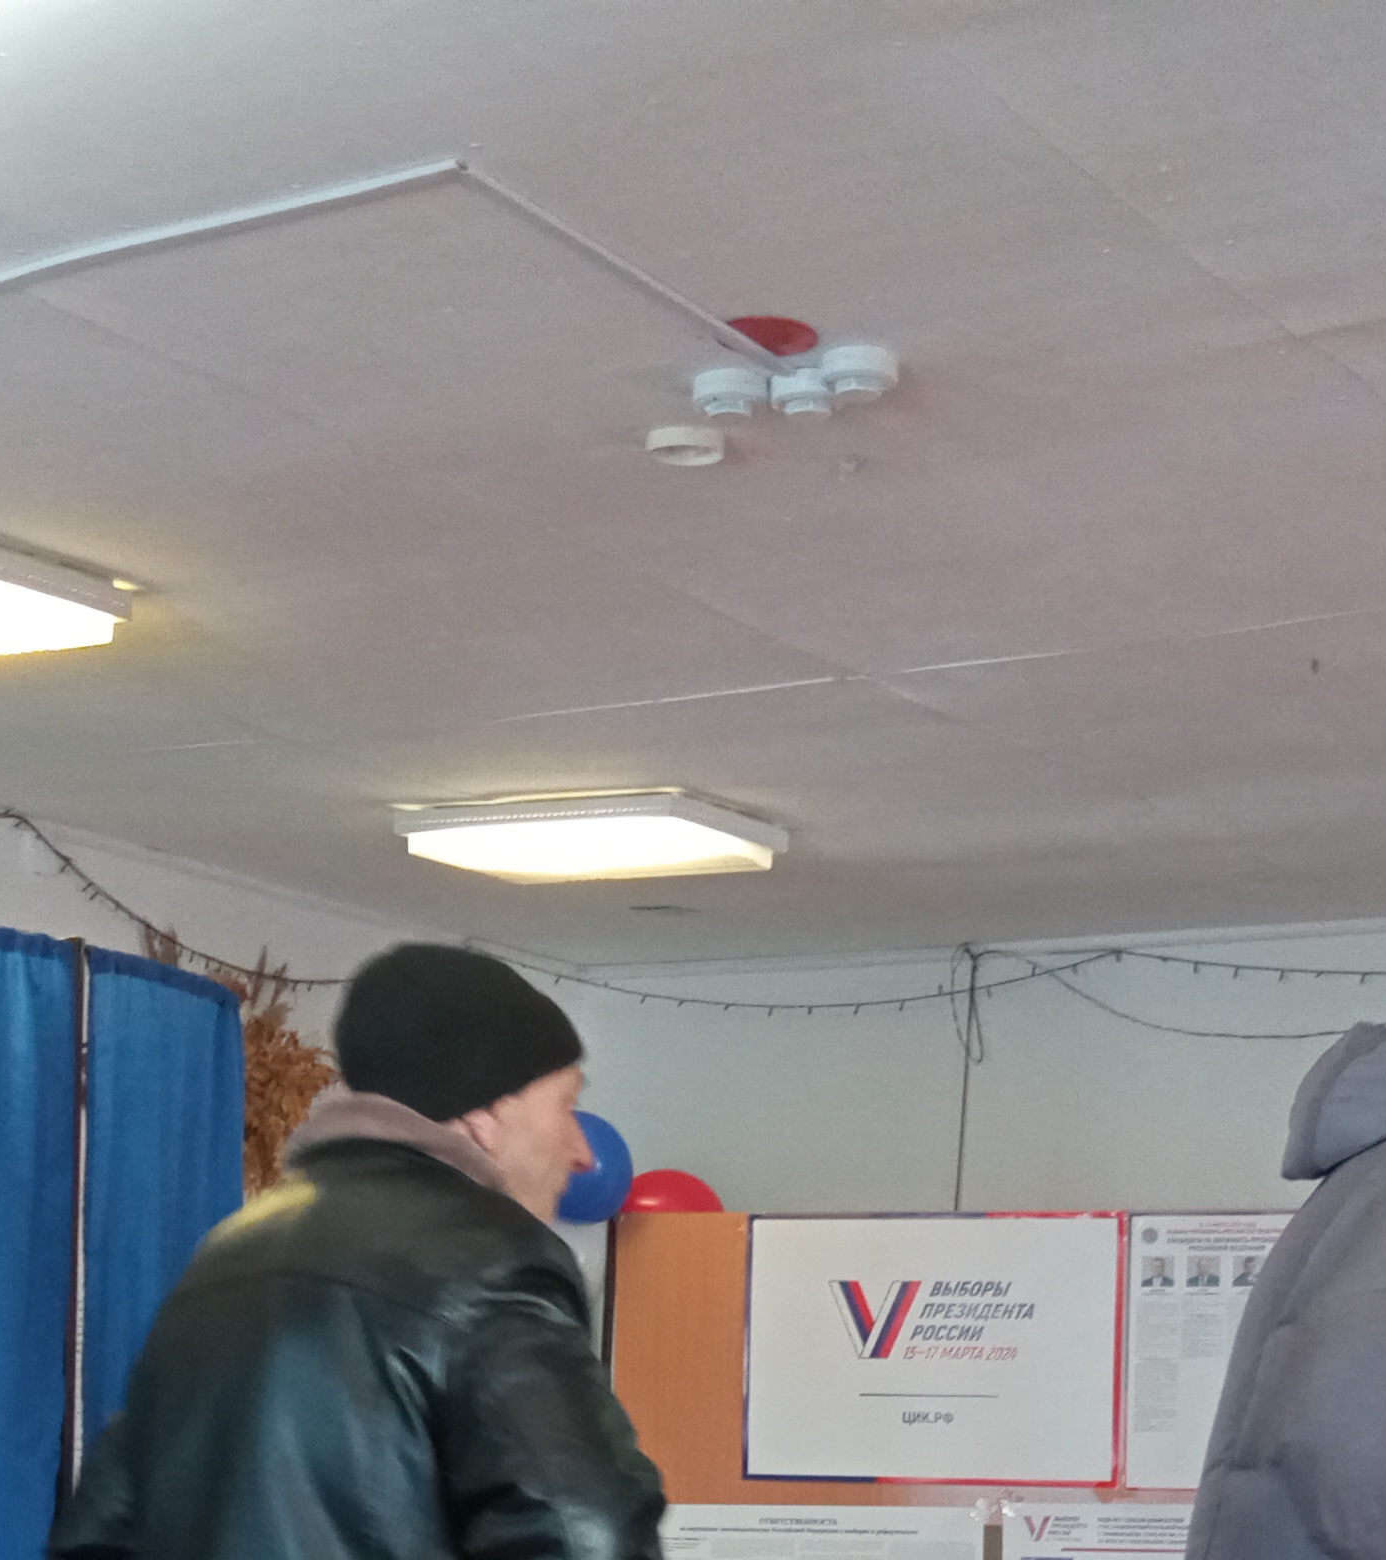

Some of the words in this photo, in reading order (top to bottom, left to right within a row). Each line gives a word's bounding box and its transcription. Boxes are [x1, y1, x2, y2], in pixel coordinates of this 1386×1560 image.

[929, 1280, 1013, 1298] ВЫБОРЫ
[919, 1302, 1036, 1321] ПРЕЗИДЕНТА
[909, 1324, 985, 1341] РОССИИ
[941, 1346, 984, 1360] МАРТА
[985, 1346, 1018, 1361] 2024
[901, 1411, 954, 1426] ЦИК.РФ
